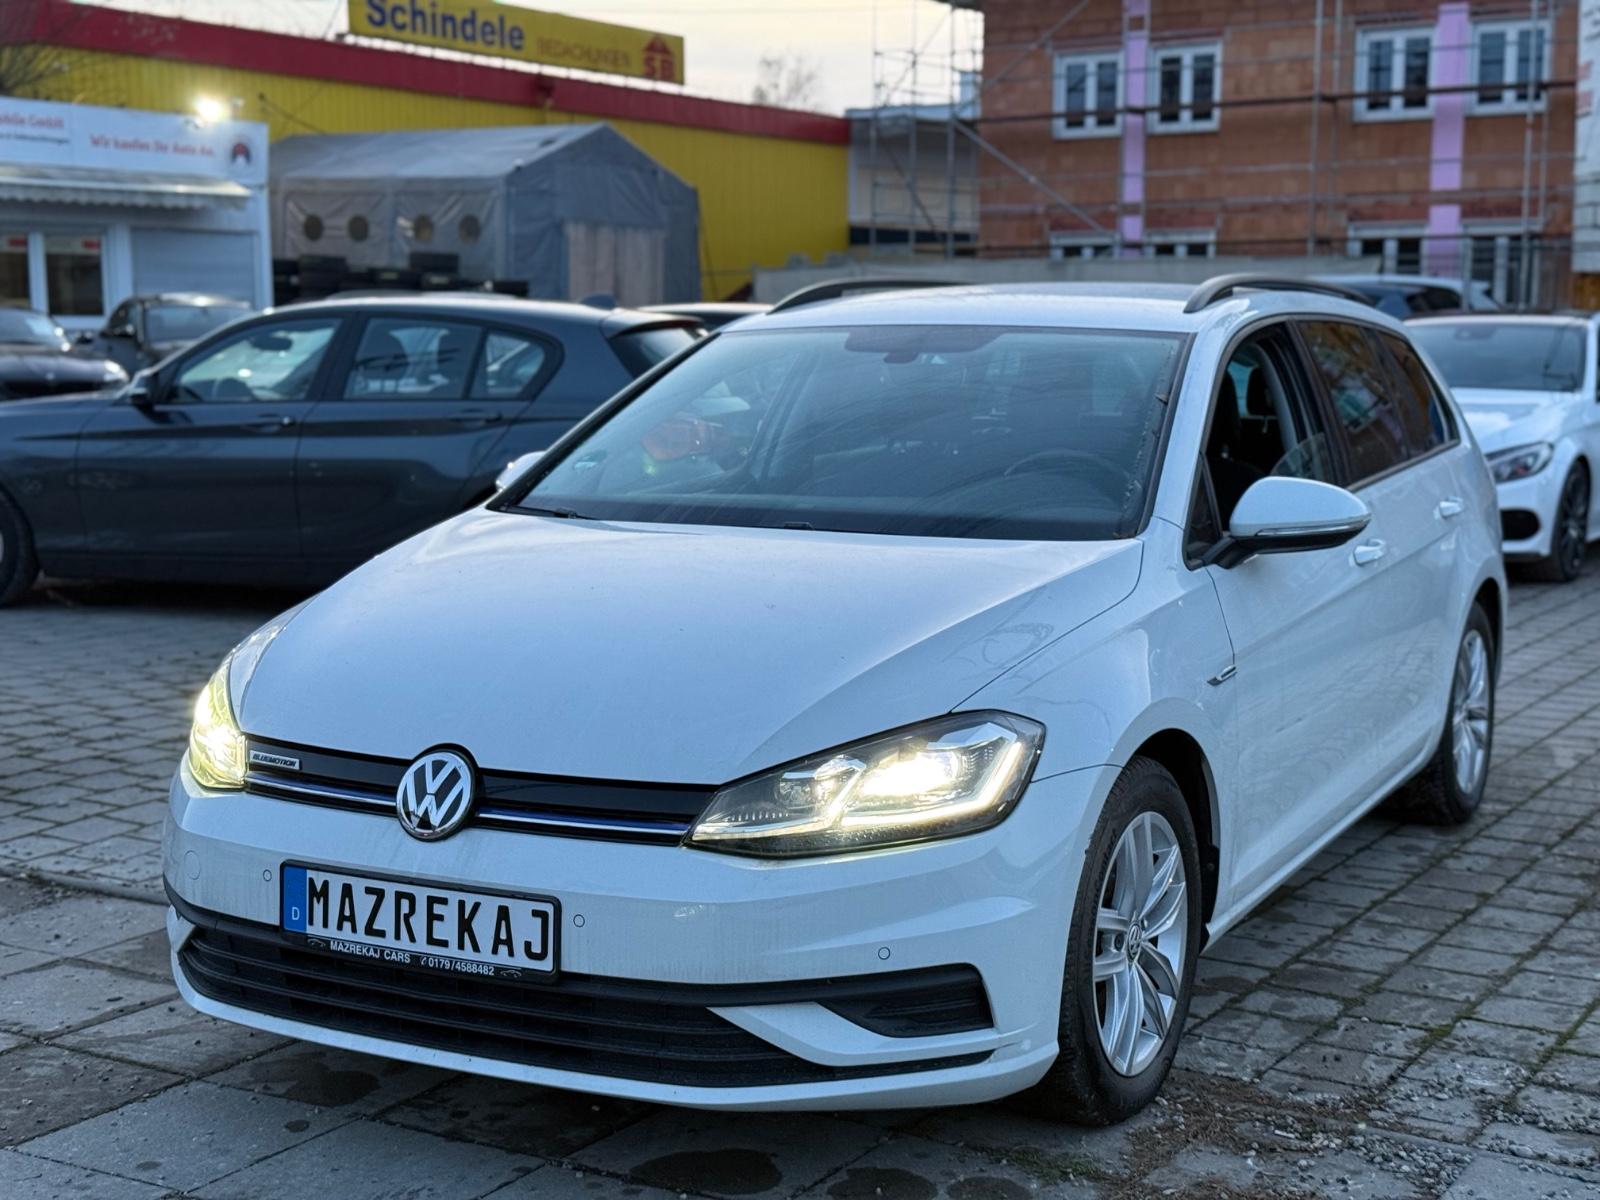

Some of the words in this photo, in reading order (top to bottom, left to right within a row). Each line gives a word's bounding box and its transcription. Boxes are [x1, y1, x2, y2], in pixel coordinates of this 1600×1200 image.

[367, 0, 524, 50] Schindele
[252, 752, 298, 767] BLUEMOTION
[400, 753, 470, 833] VW
[291, 906, 300, 921] D
[307, 876, 550, 961] MAZREKAJ
[330, 940, 380, 959] MAZREKAJ
[384, 950, 411, 964] CARS
